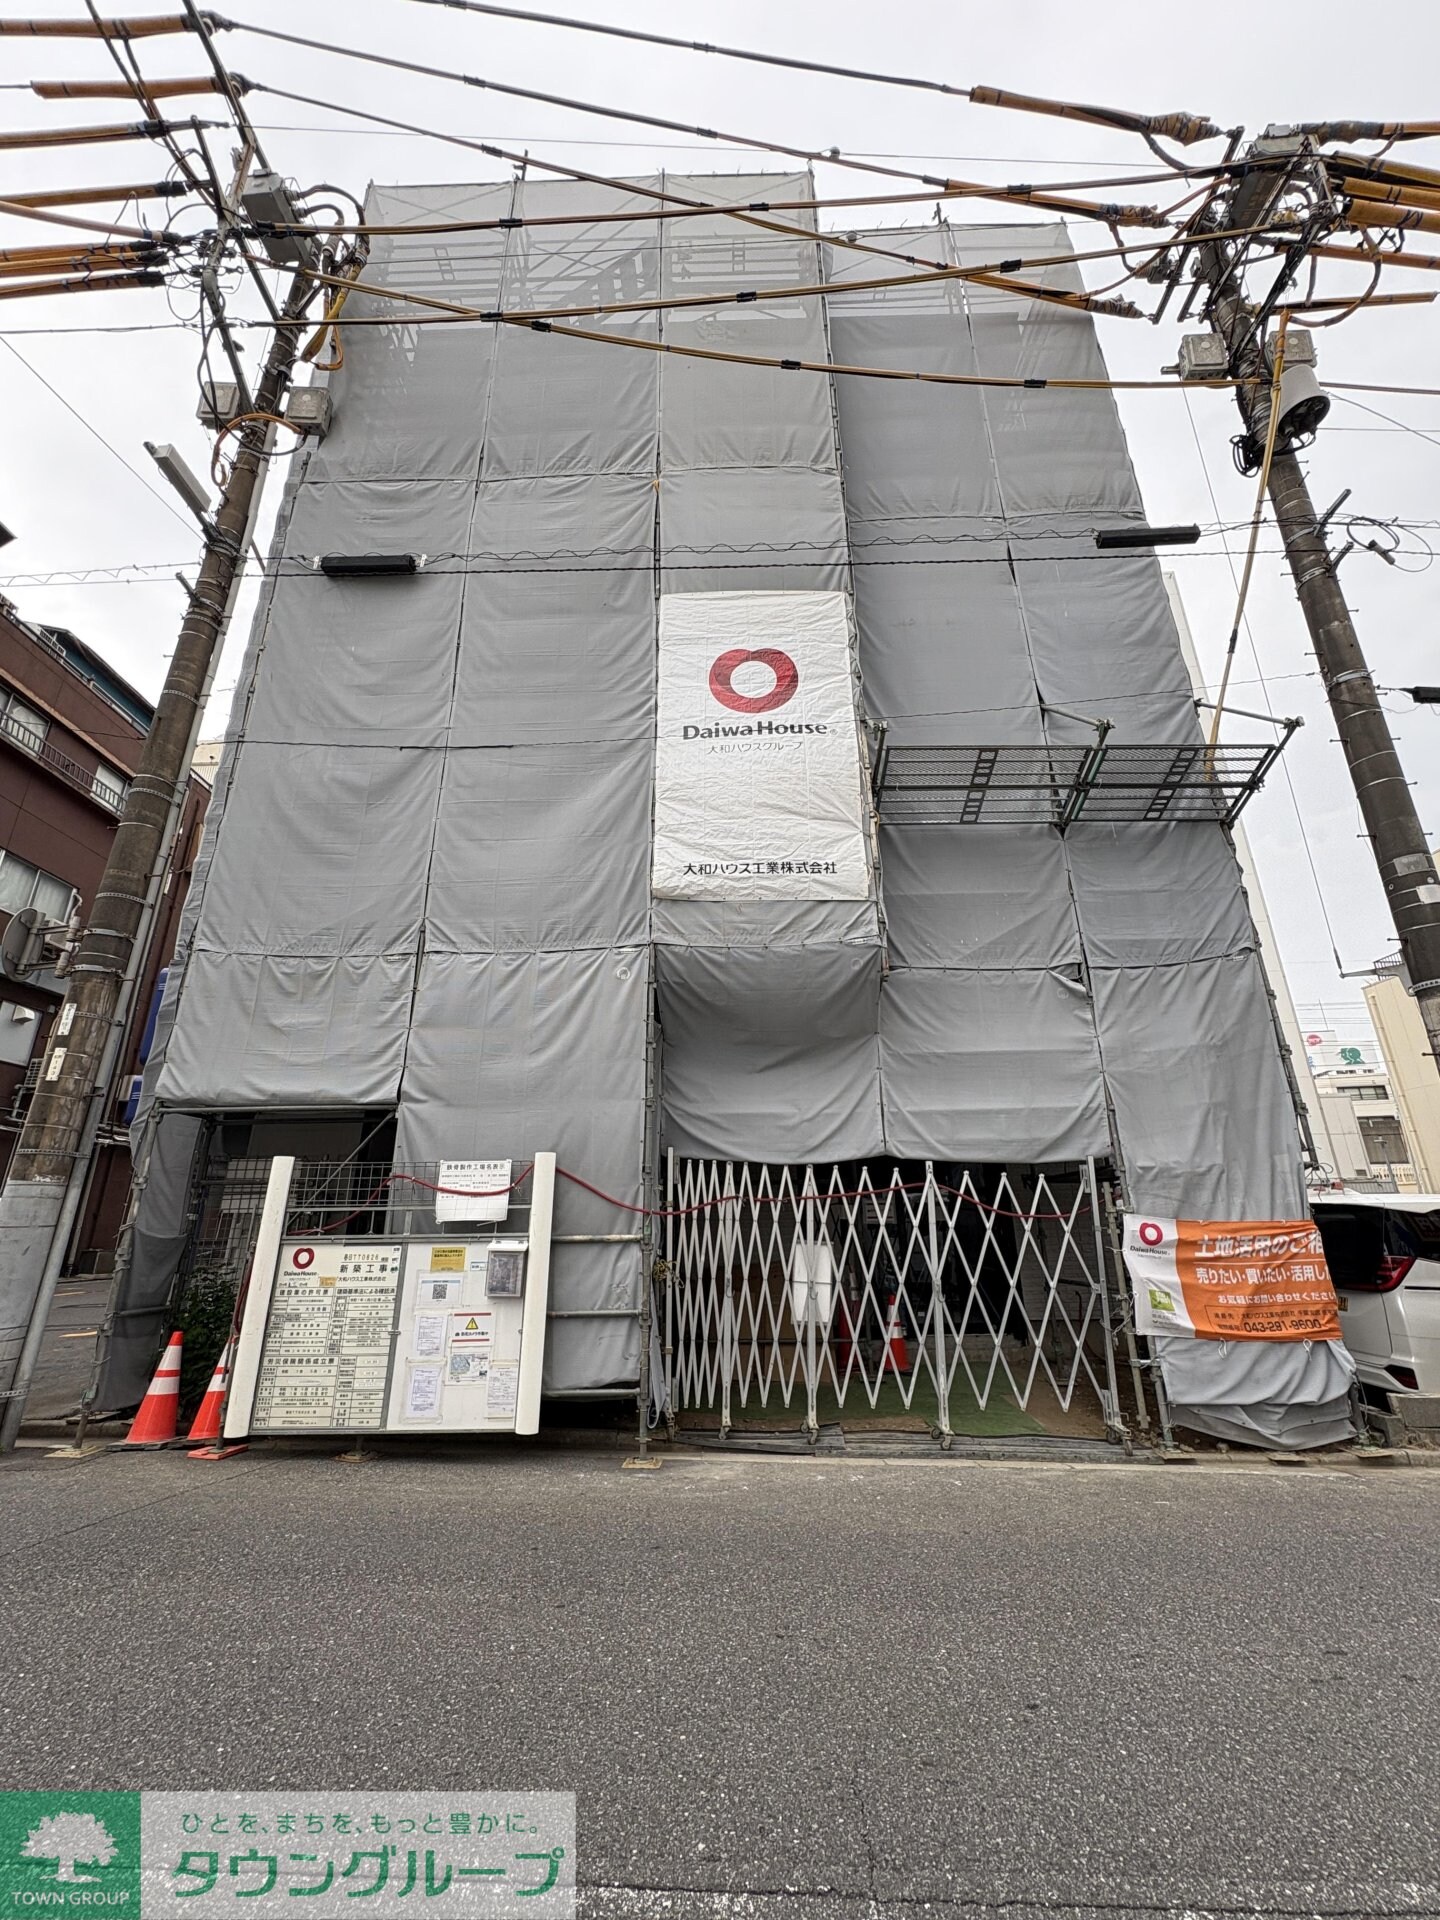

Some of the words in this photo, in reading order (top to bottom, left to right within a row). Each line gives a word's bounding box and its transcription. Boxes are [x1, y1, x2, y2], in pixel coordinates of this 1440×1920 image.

[706, 741, 804, 755] 大和ハウスグループ
[682, 861, 838, 876] 大和ハウス工業株式会社
[339, 1264, 388, 1274] 新築工事
